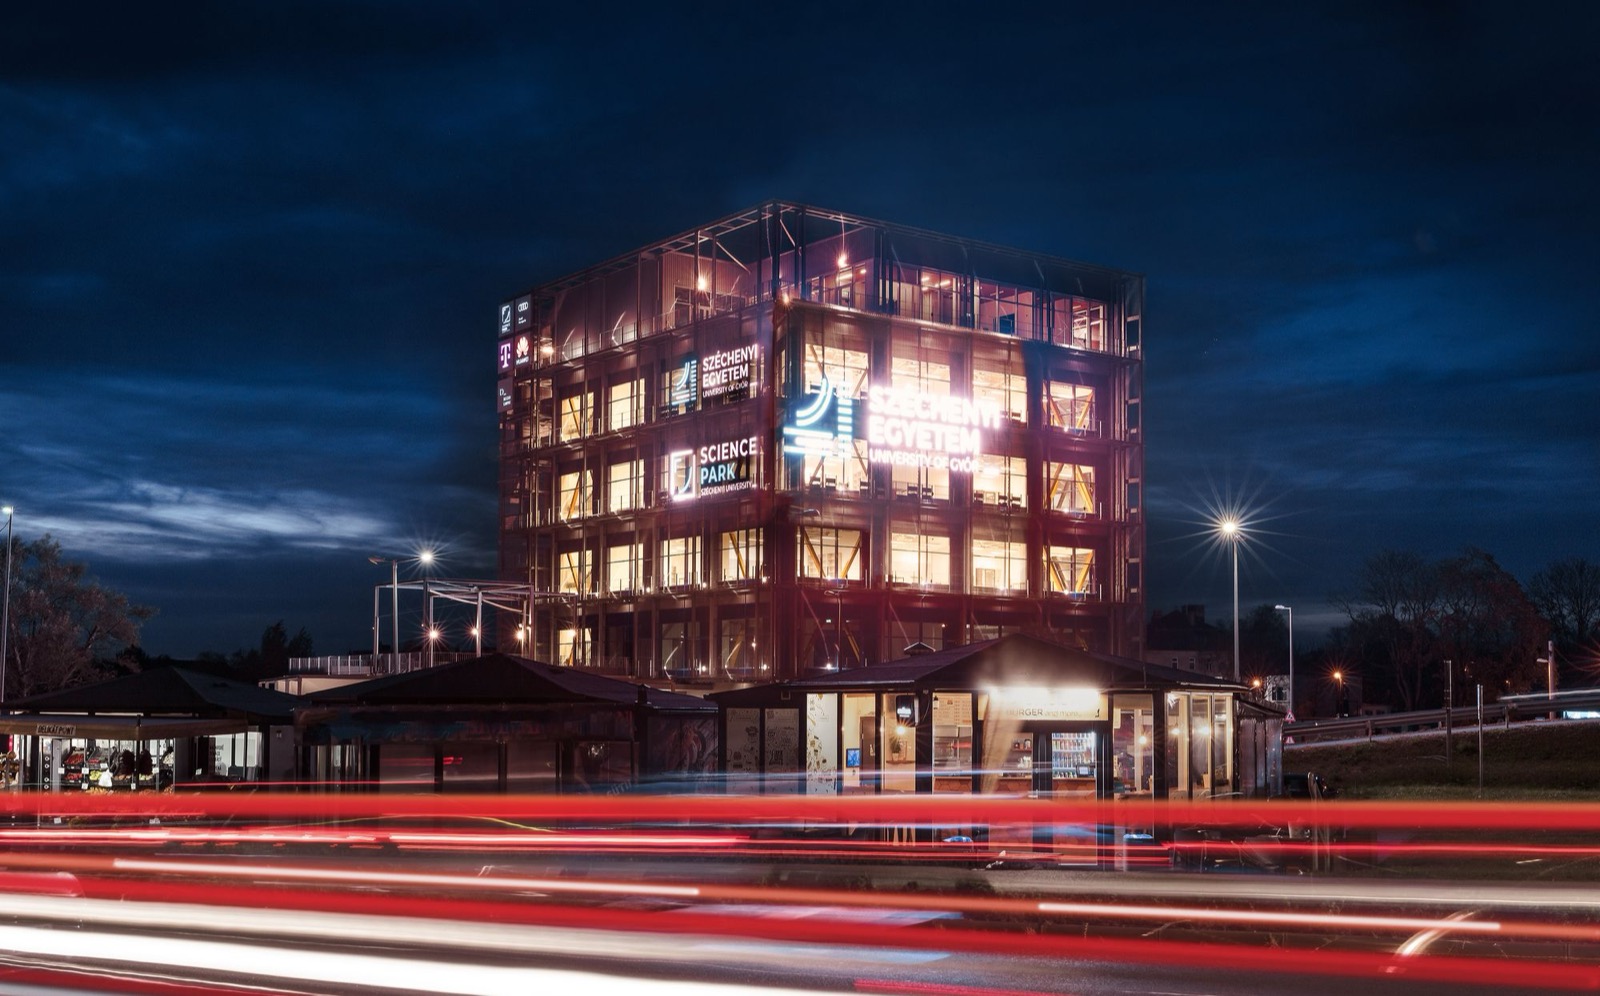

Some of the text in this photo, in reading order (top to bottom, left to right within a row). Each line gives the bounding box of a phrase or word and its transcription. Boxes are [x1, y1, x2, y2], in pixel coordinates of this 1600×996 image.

[703, 343, 758, 371] SZÉCHENYI
[703, 363, 748, 388] EGYETEM
[703, 386, 727, 398] UNIVERSITY
[869, 384, 1000, 428] SZÉCHENYI
[869, 415, 980, 454] EGYETEM
[700, 436, 757, 464] SCIENCE
[869, 448, 931, 467] UNIVERSITY
[933, 456, 949, 468] OF
[700, 462, 735, 485] PARK
[726, 480, 753, 492] UNIVERSITY
[1006, 708, 1043, 716] BURGER
